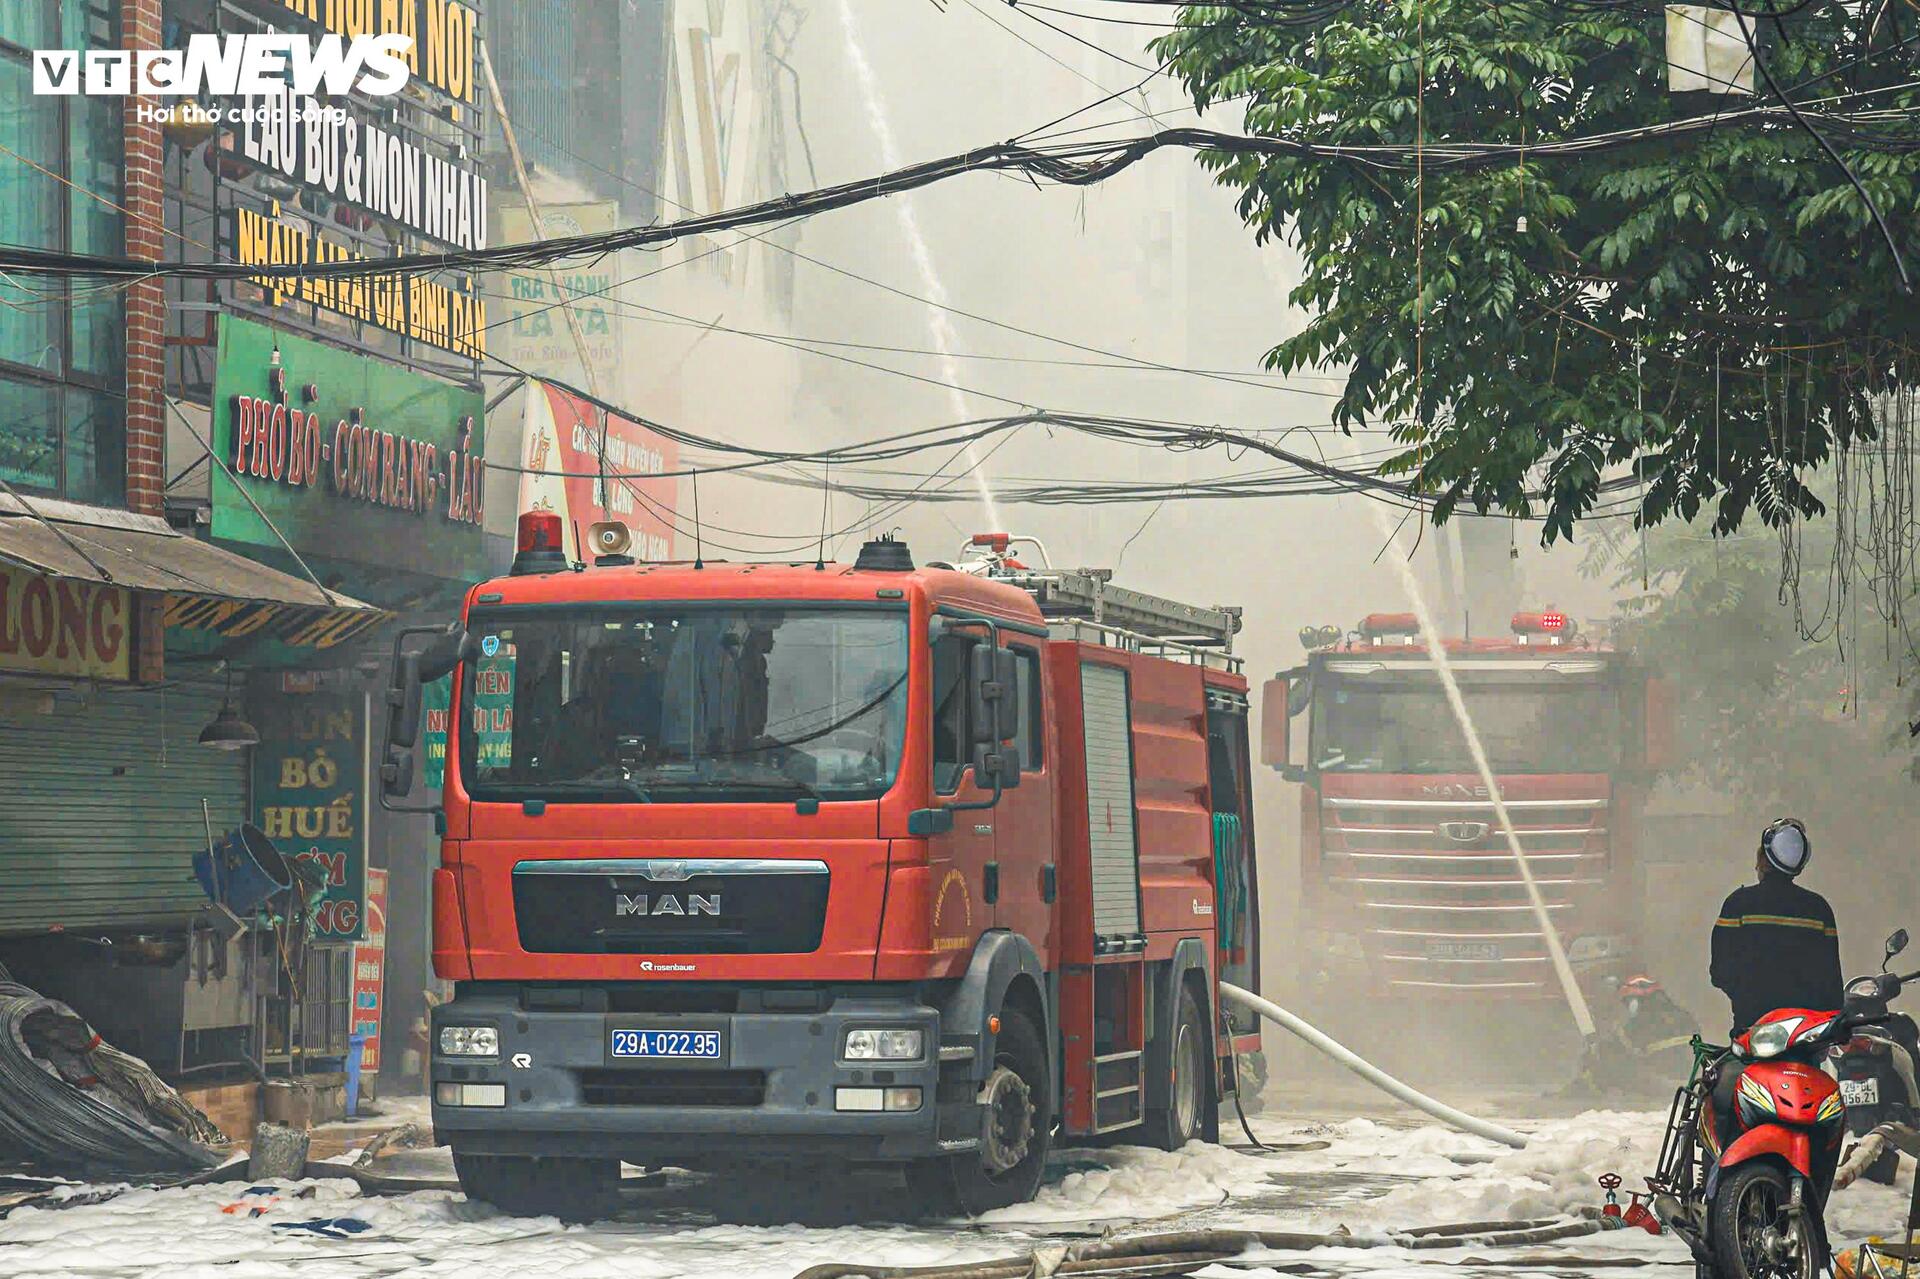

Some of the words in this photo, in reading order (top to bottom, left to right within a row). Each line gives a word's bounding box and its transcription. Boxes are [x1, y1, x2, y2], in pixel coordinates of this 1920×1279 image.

[344, 116, 361, 203] &
[366, 109, 420, 229] MÓN
[453, 276, 487, 361] DÂN
[238, 368, 289, 482] PHỞ
[288, 384, 320, 488] BÒ
[334, 407, 379, 503] CƠM
[380, 435, 437, 513] RANG
[448, 416, 487, 526] LẨU
[278, 747, 338, 789] BÒ
[263, 791, 354, 839] HUẾ
[616, 894, 721, 916] MAN
[615, 1033, 718, 1055] 29A-022.95
